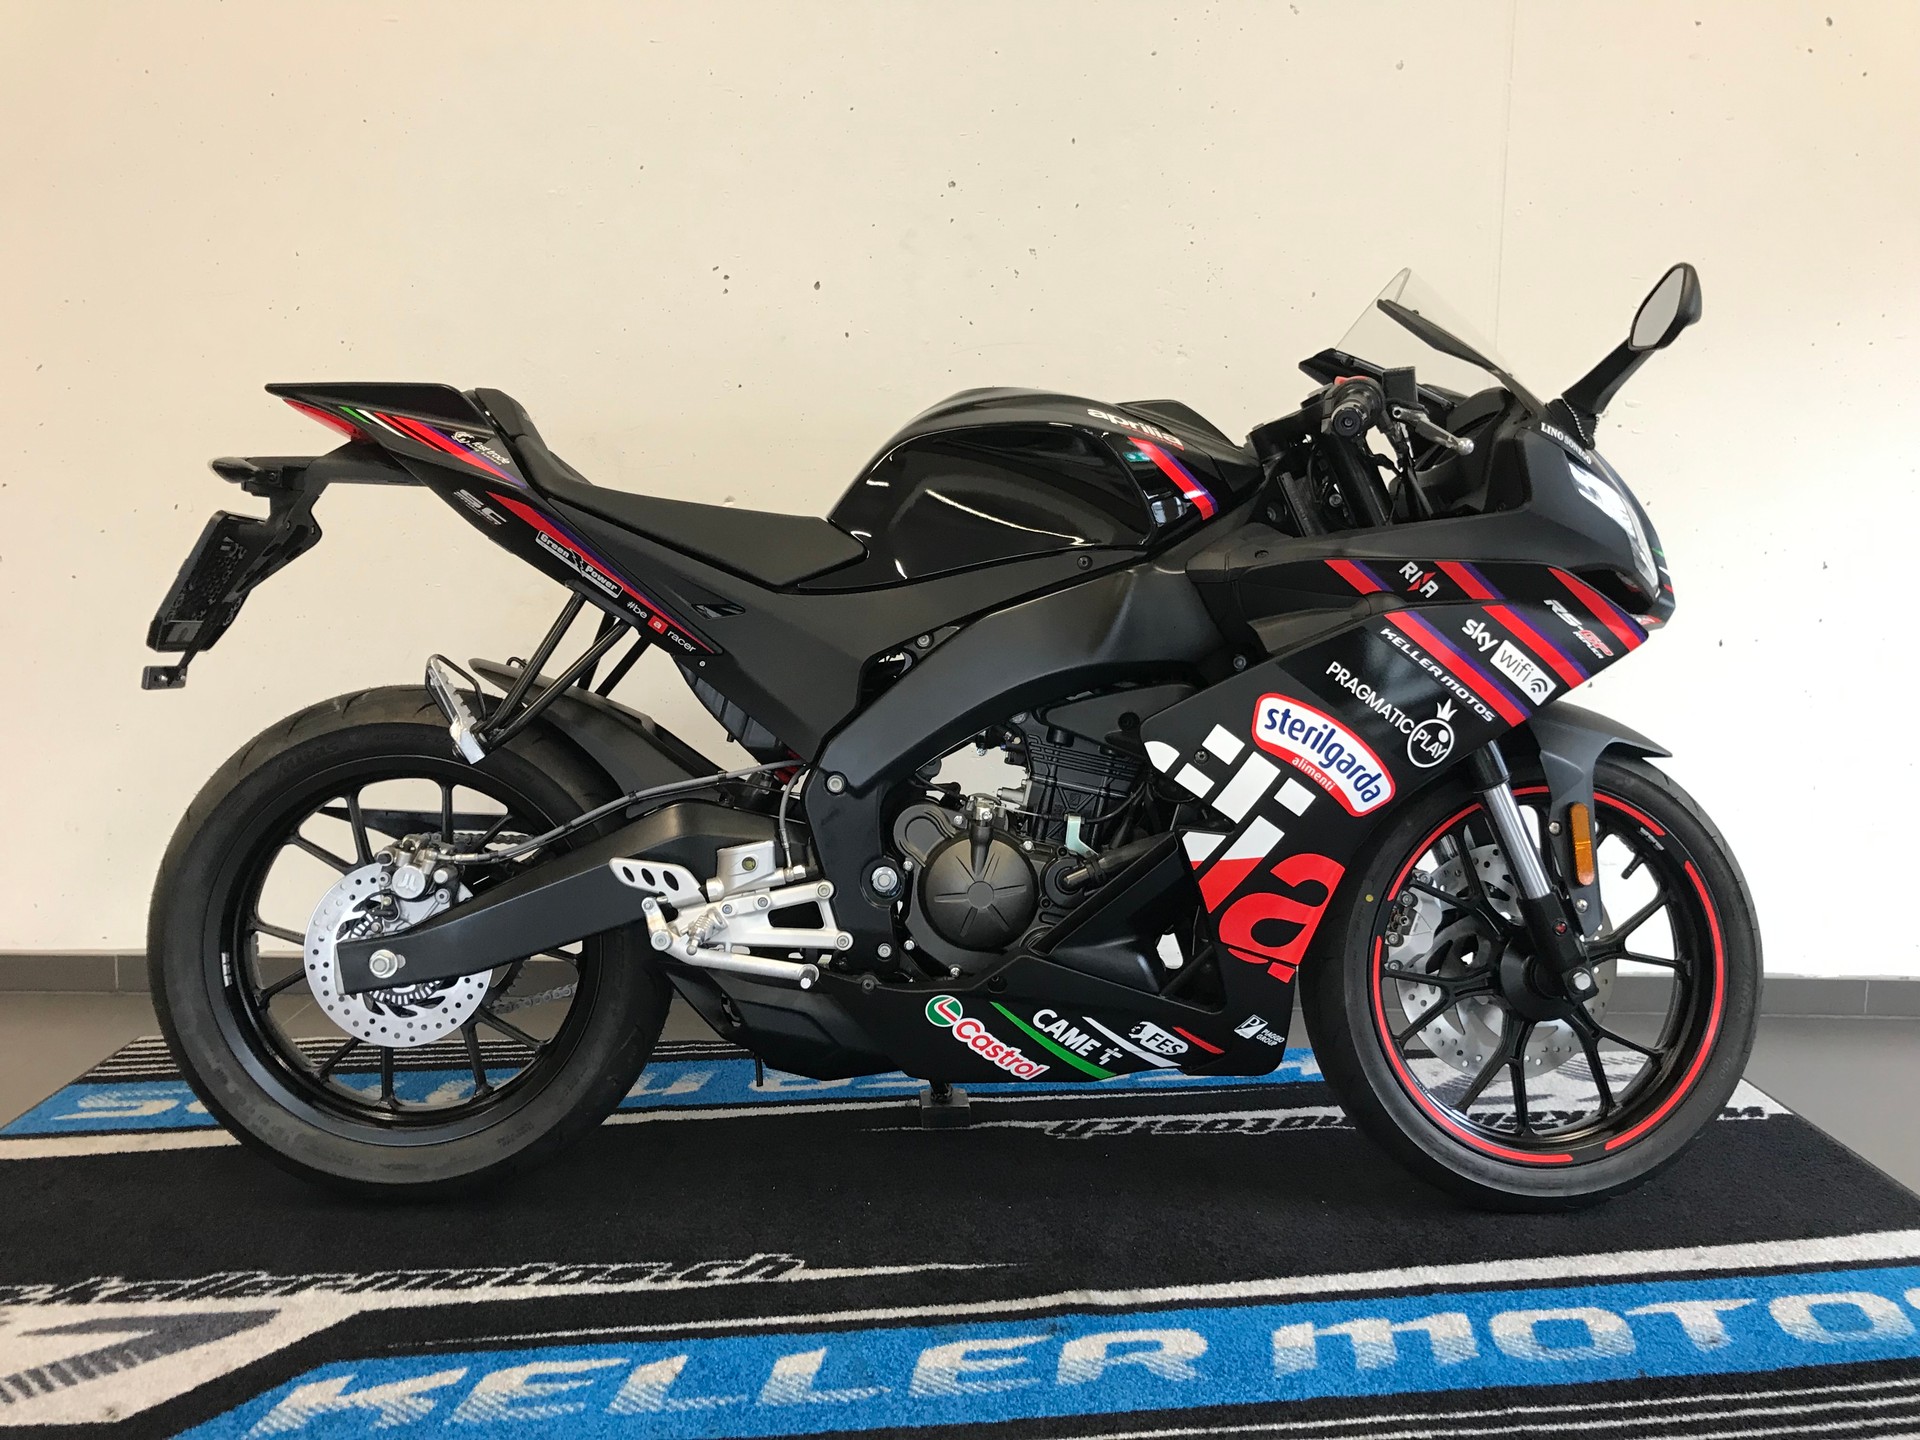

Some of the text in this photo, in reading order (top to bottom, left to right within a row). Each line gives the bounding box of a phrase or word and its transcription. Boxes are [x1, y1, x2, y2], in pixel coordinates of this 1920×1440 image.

[1087, 408, 1184, 448] aprilia
[1541, 421, 1564, 442] LINO
[539, 533, 619, 592] Green Power
[626, 600, 648, 620] #be
[666, 629, 697, 653] racer
[1461, 618, 1536, 687] sky wifi
[1380, 627, 1496, 724] KELLER MOTOS
[1325, 660, 1448, 762] PRAGMATIC PLAY
[1264, 707, 1383, 804] sterilgarda
[1291, 755, 1336, 793] alimenti
[954, 1020, 1045, 1079] Castrol
[1032, 1009, 1102, 1058] CAME
[1256, 1033, 1278, 1047] GROUP
[1261, 1028, 1286, 1044] PIAGGIO
[240, 1284, 1920, 1440] KELLER MOTO
